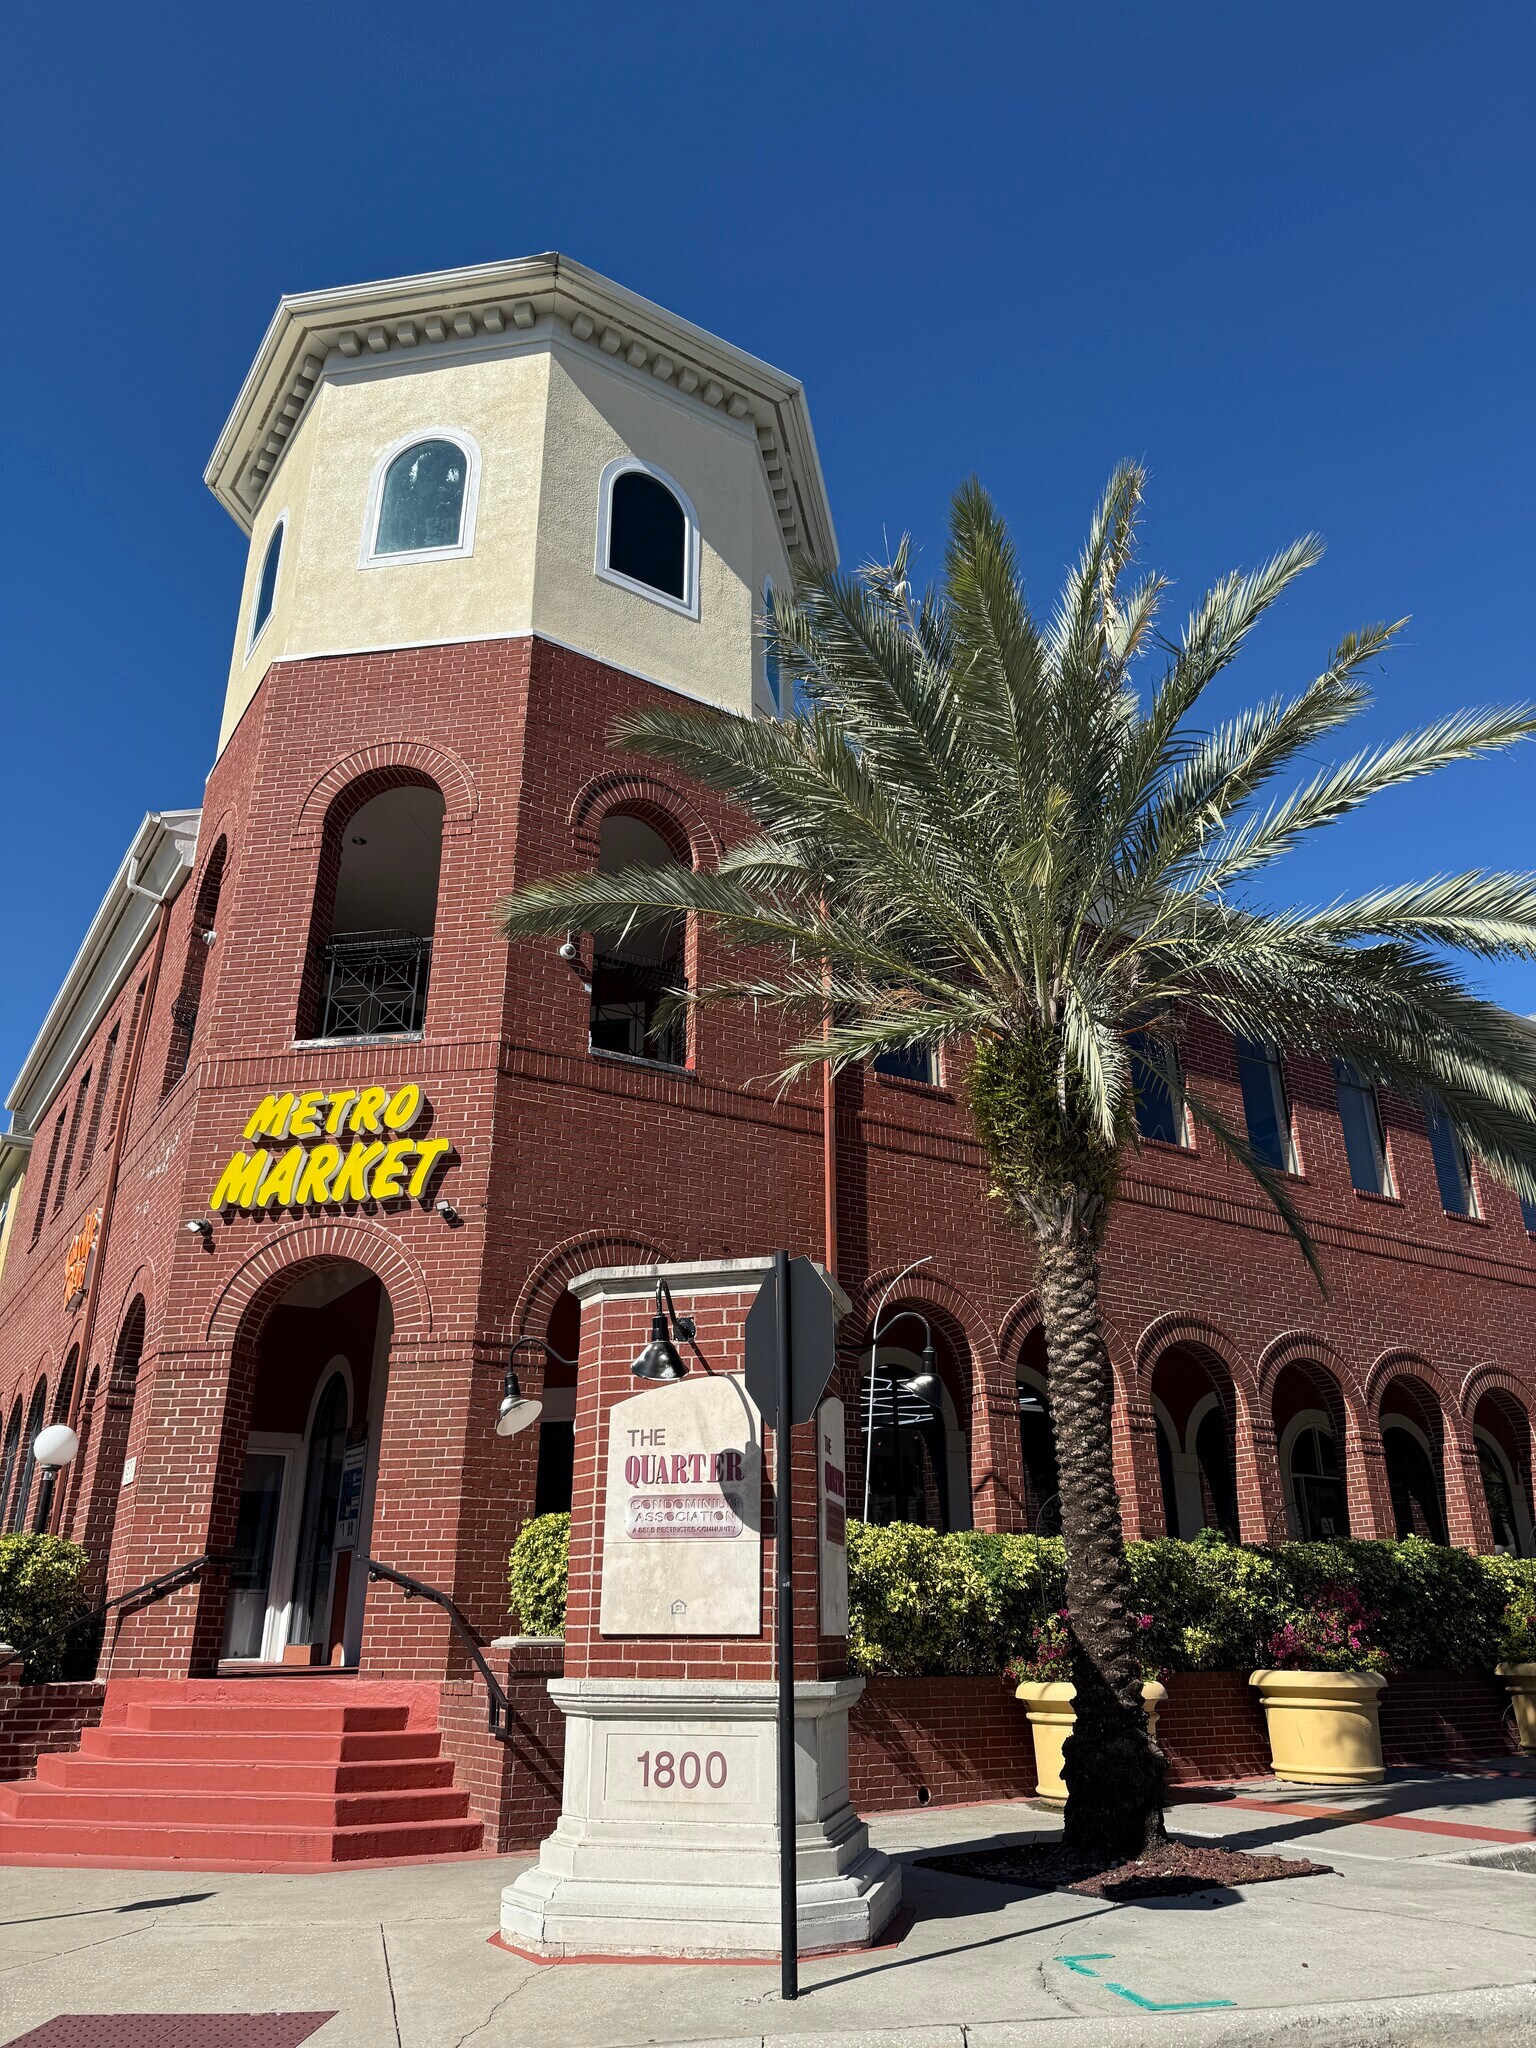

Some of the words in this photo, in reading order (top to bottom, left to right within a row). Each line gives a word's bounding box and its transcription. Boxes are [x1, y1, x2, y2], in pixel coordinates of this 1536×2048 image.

[243, 1083, 424, 1142] METRO
[210, 1138, 452, 1211] MARKET
[627, 1428, 666, 1447] THE
[625, 1452, 745, 1488] QUARTER
[630, 1498, 740, 1510] CONDOMINIUM
[634, 1510, 736, 1522] ASSOCIATION
[637, 1750, 728, 1789] 1800
